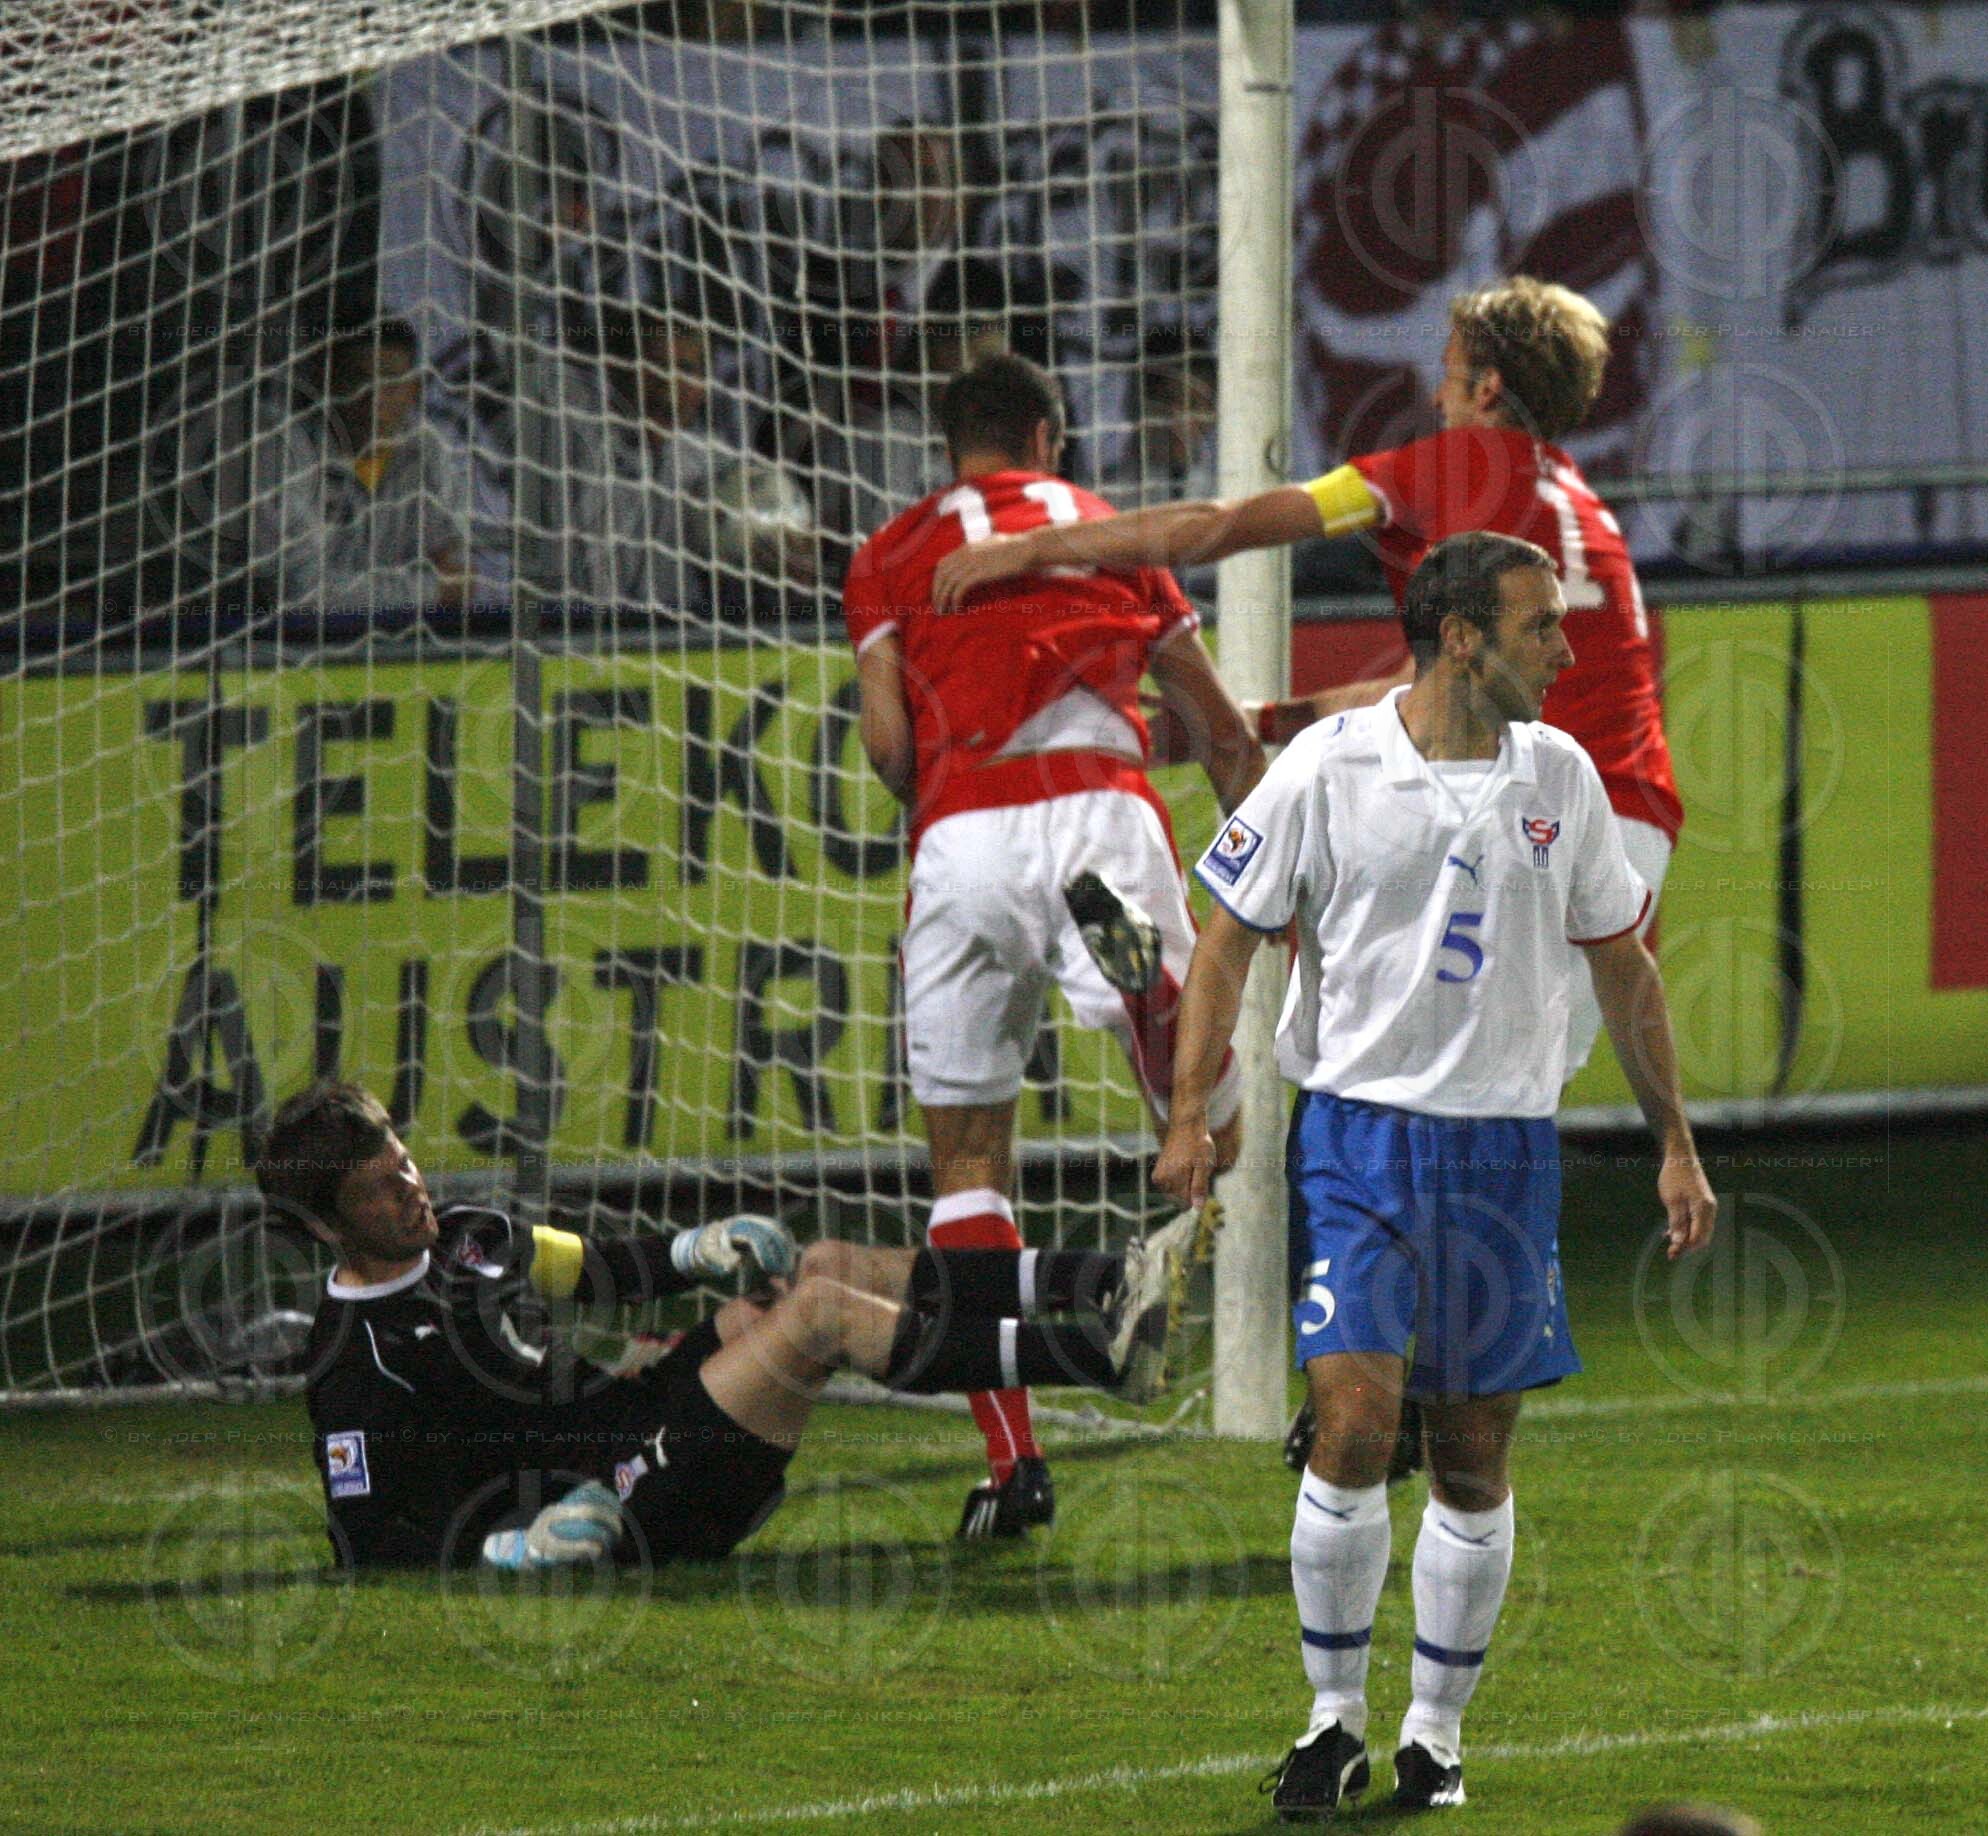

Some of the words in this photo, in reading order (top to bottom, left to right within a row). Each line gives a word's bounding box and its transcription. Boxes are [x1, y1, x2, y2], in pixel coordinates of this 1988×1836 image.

[144, 680, 908, 904] TELEKO
[1436, 912, 1485, 984] 5
[1301, 1258, 1336, 1336] 5
